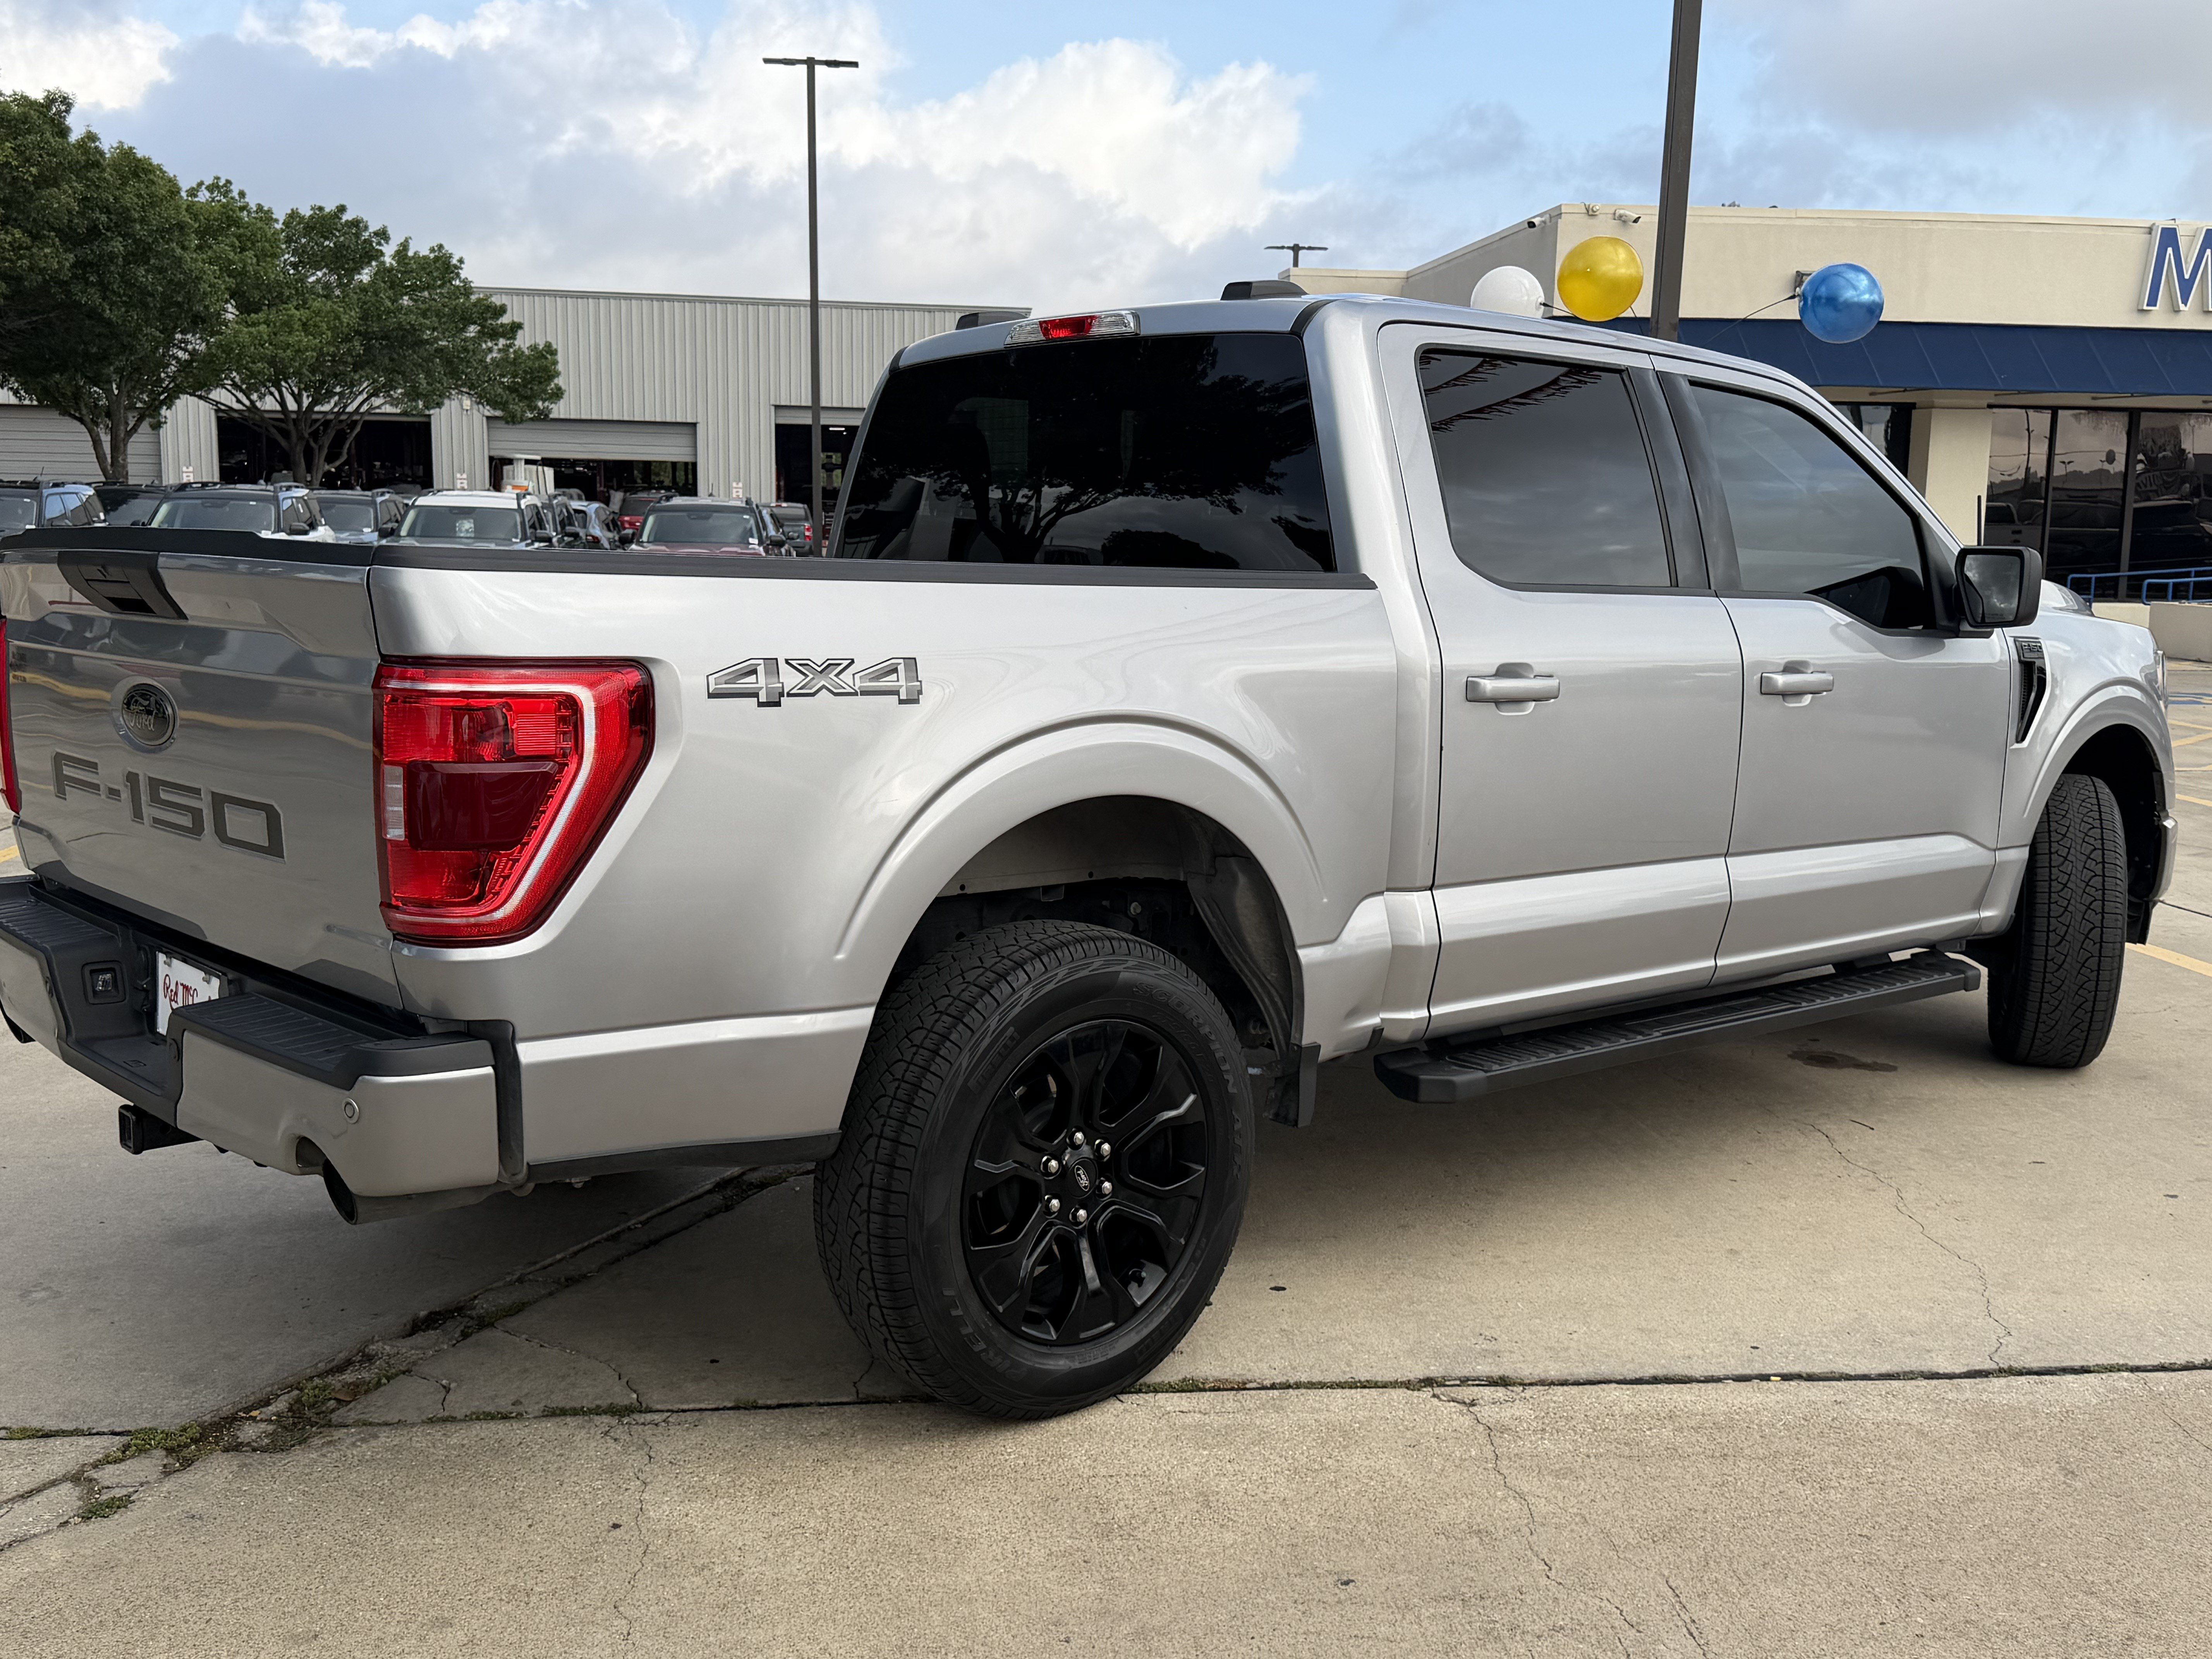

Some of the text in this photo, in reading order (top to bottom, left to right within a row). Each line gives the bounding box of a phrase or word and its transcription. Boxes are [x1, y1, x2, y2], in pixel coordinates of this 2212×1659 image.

[53, 750, 285, 860] F-150
[163, 974, 179, 1012] Red
[1132, 982, 1236, 1094] SCORPION
[942, 1287, 1026, 1380] PIRELLI
